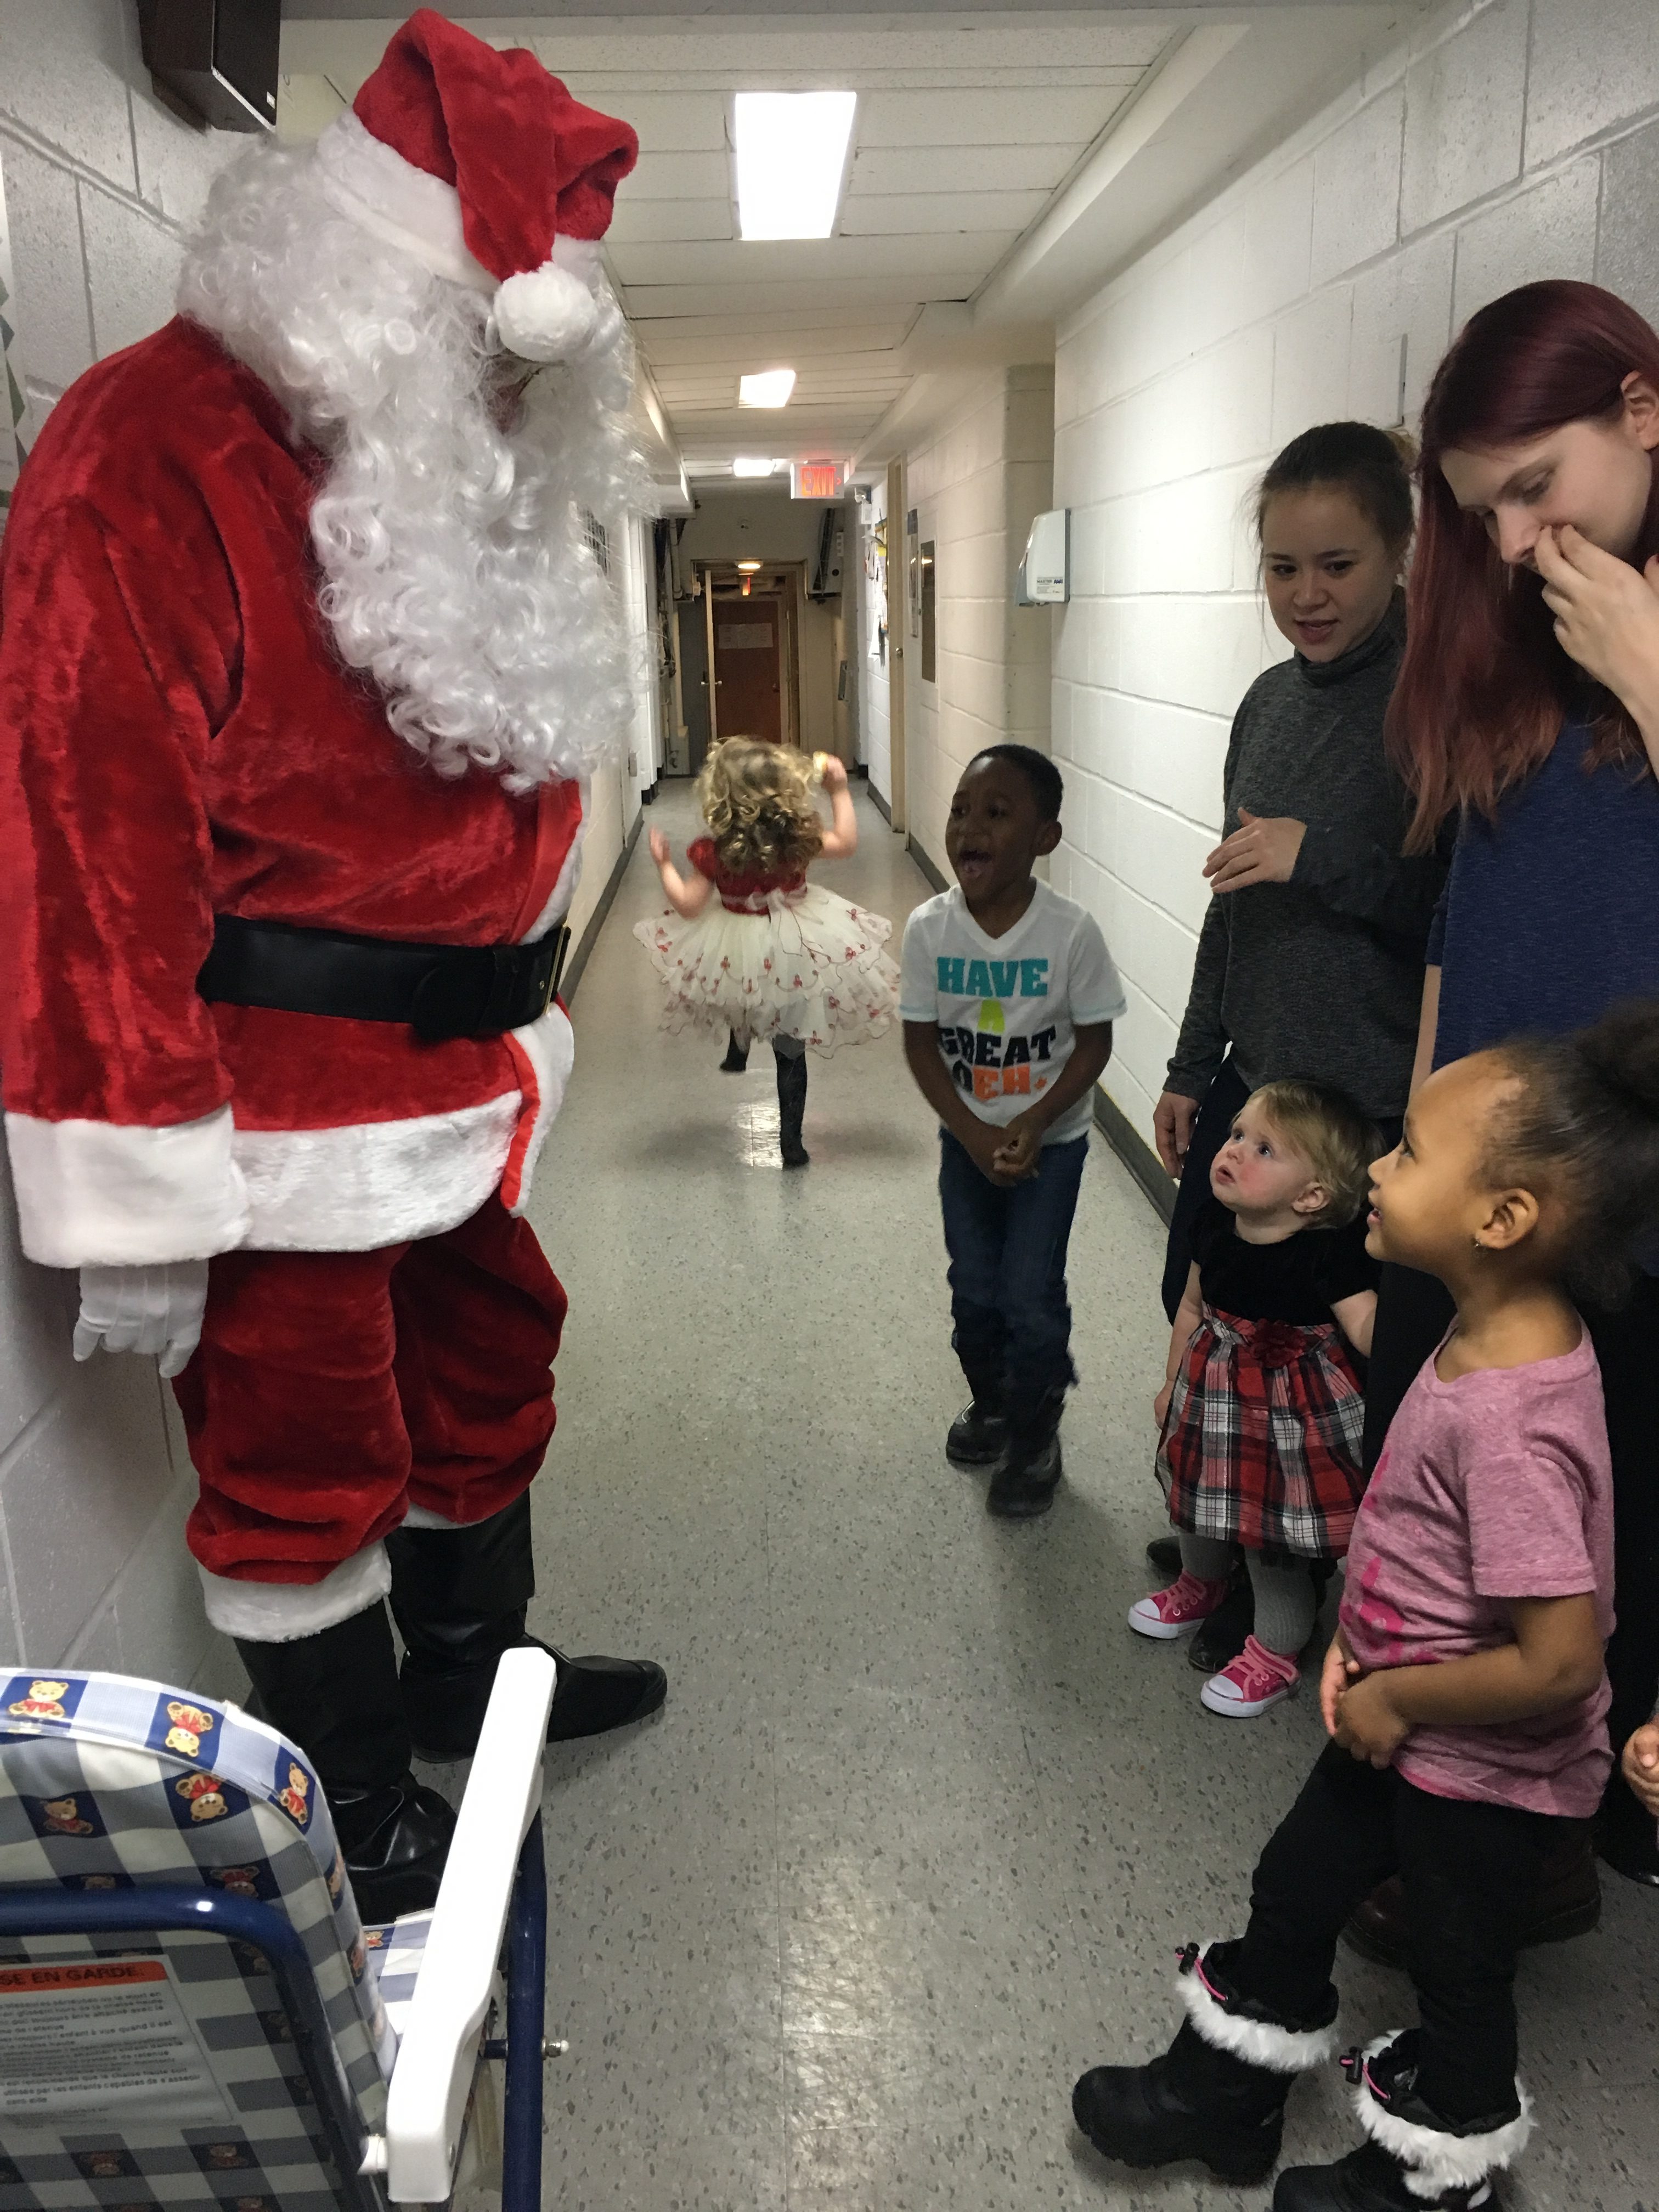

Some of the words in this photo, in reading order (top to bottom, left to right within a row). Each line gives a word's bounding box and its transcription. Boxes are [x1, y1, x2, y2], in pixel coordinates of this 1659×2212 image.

[802, 466, 836, 496] EXIT
[936, 956, 1049, 997] HAVE
[977, 1000, 1005, 1033] A
[939, 1024, 1057, 1068] GREAT
[31, 1971, 60, 1983] EN
